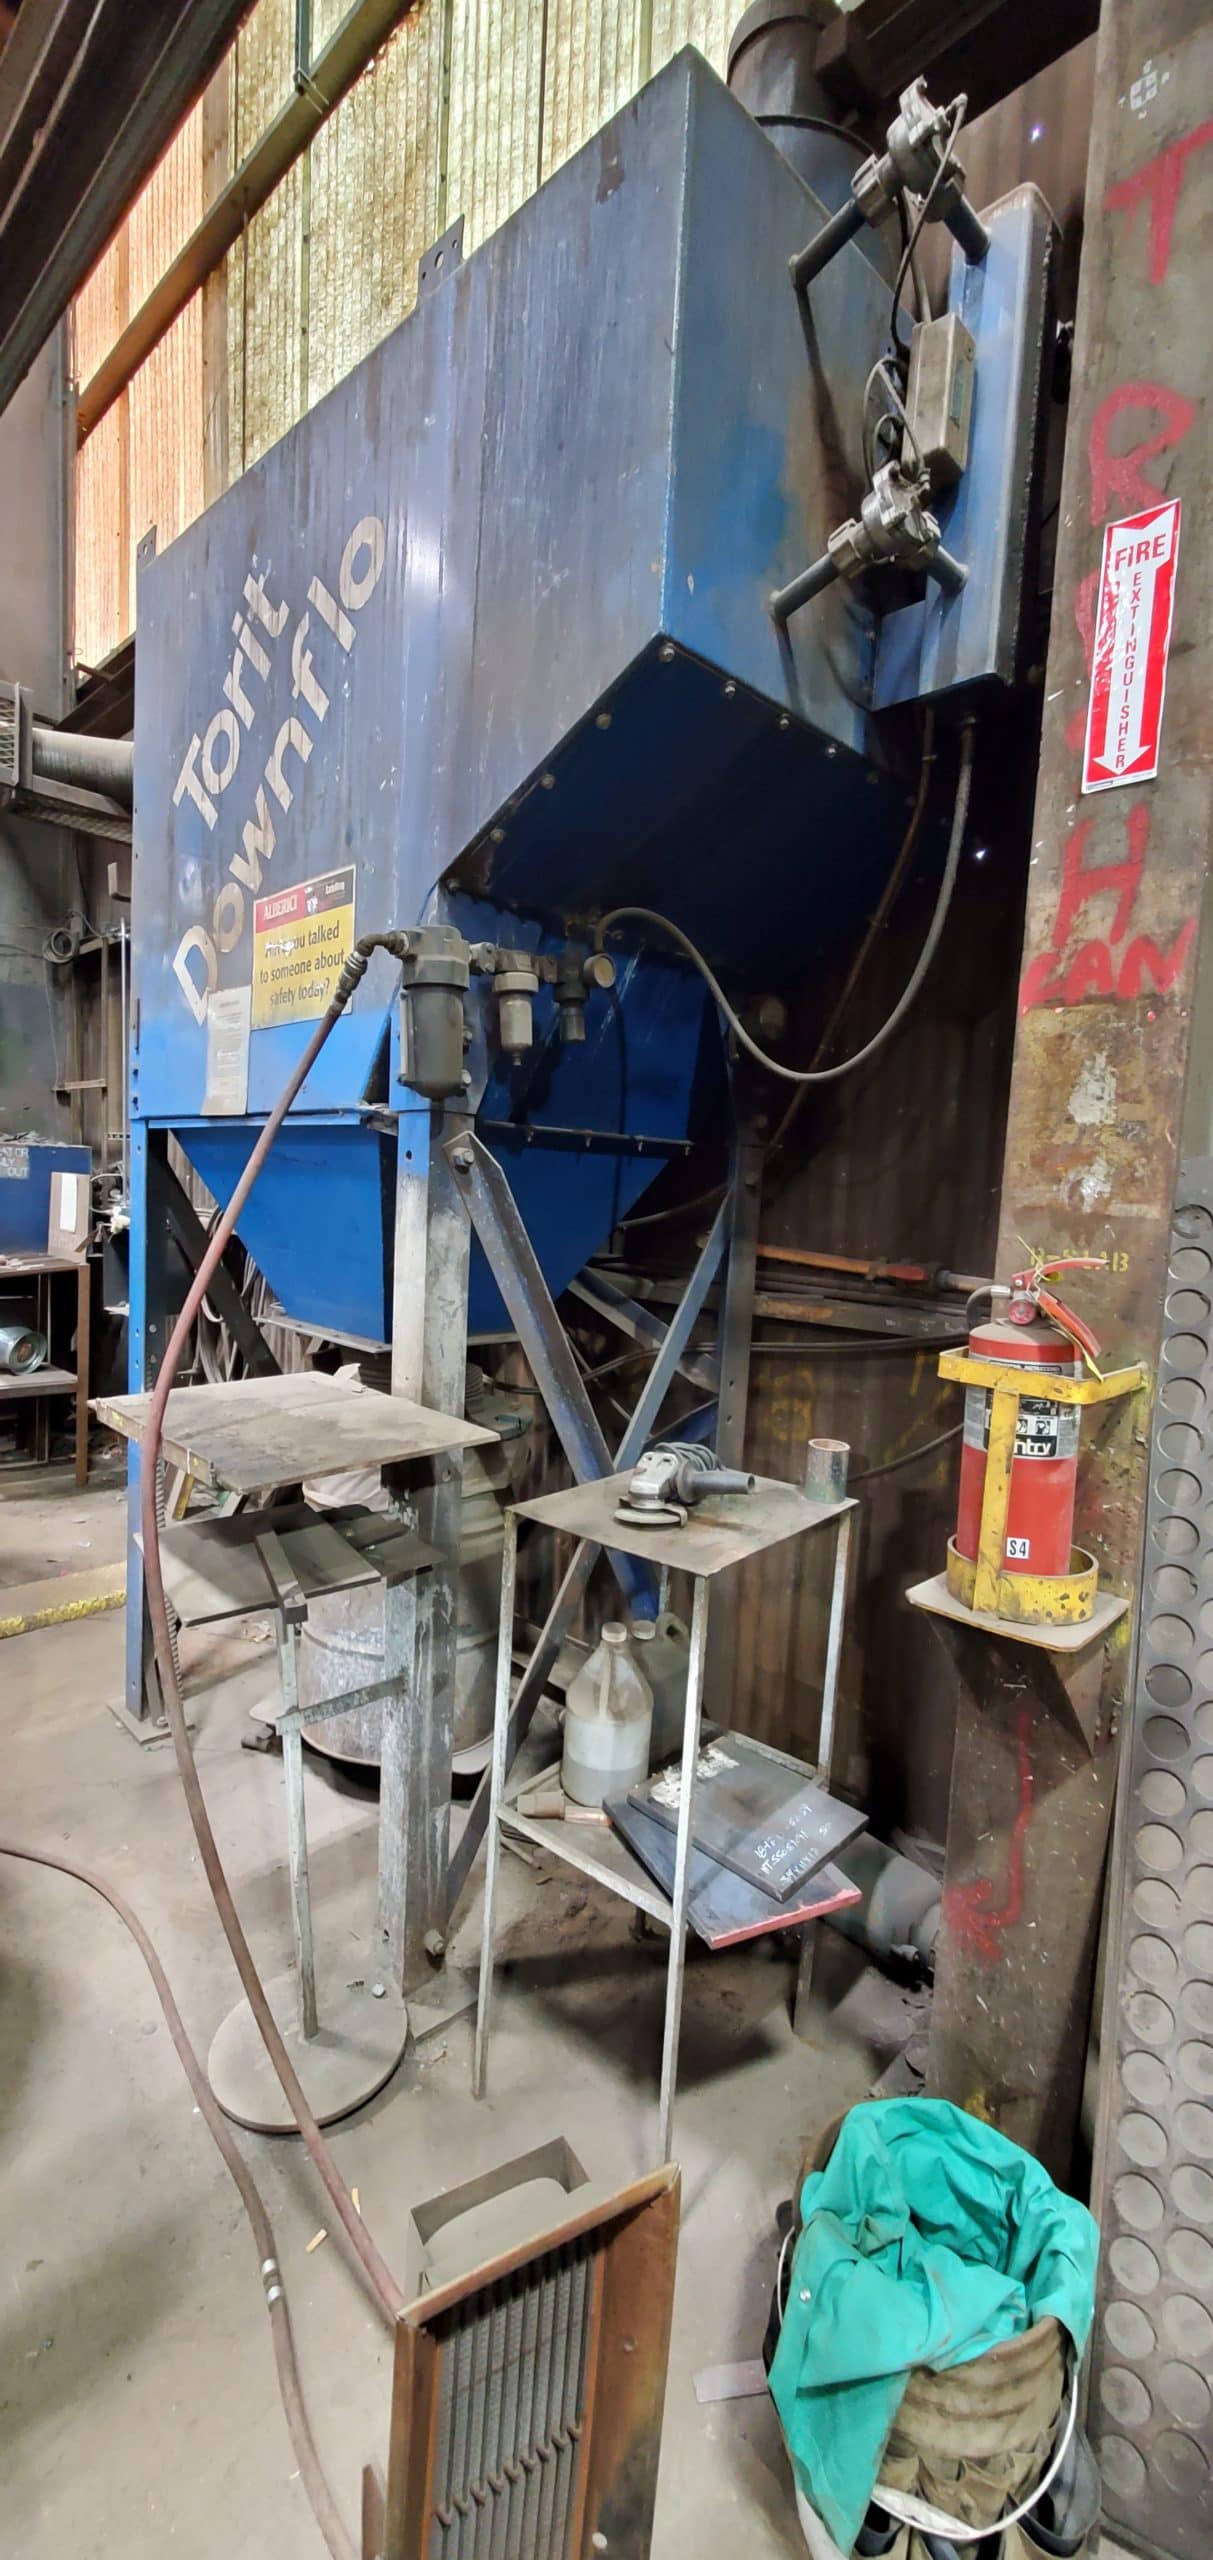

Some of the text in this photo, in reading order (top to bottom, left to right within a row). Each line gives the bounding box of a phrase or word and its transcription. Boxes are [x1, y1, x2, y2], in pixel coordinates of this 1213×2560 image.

[1115, 534, 1166, 571] FIRE
[1116, 572, 1142, 768] EXTINGUISHER
[173, 572, 289, 831] Torit
[173, 516, 386, 1026] Downflo
[308, 920, 339, 946] talked
[260, 948, 344, 984] to someone about
[270, 977, 330, 1006] safety today?
[1013, 1439, 1051, 1455] ntry
[1010, 1540, 1026, 1556] S4
